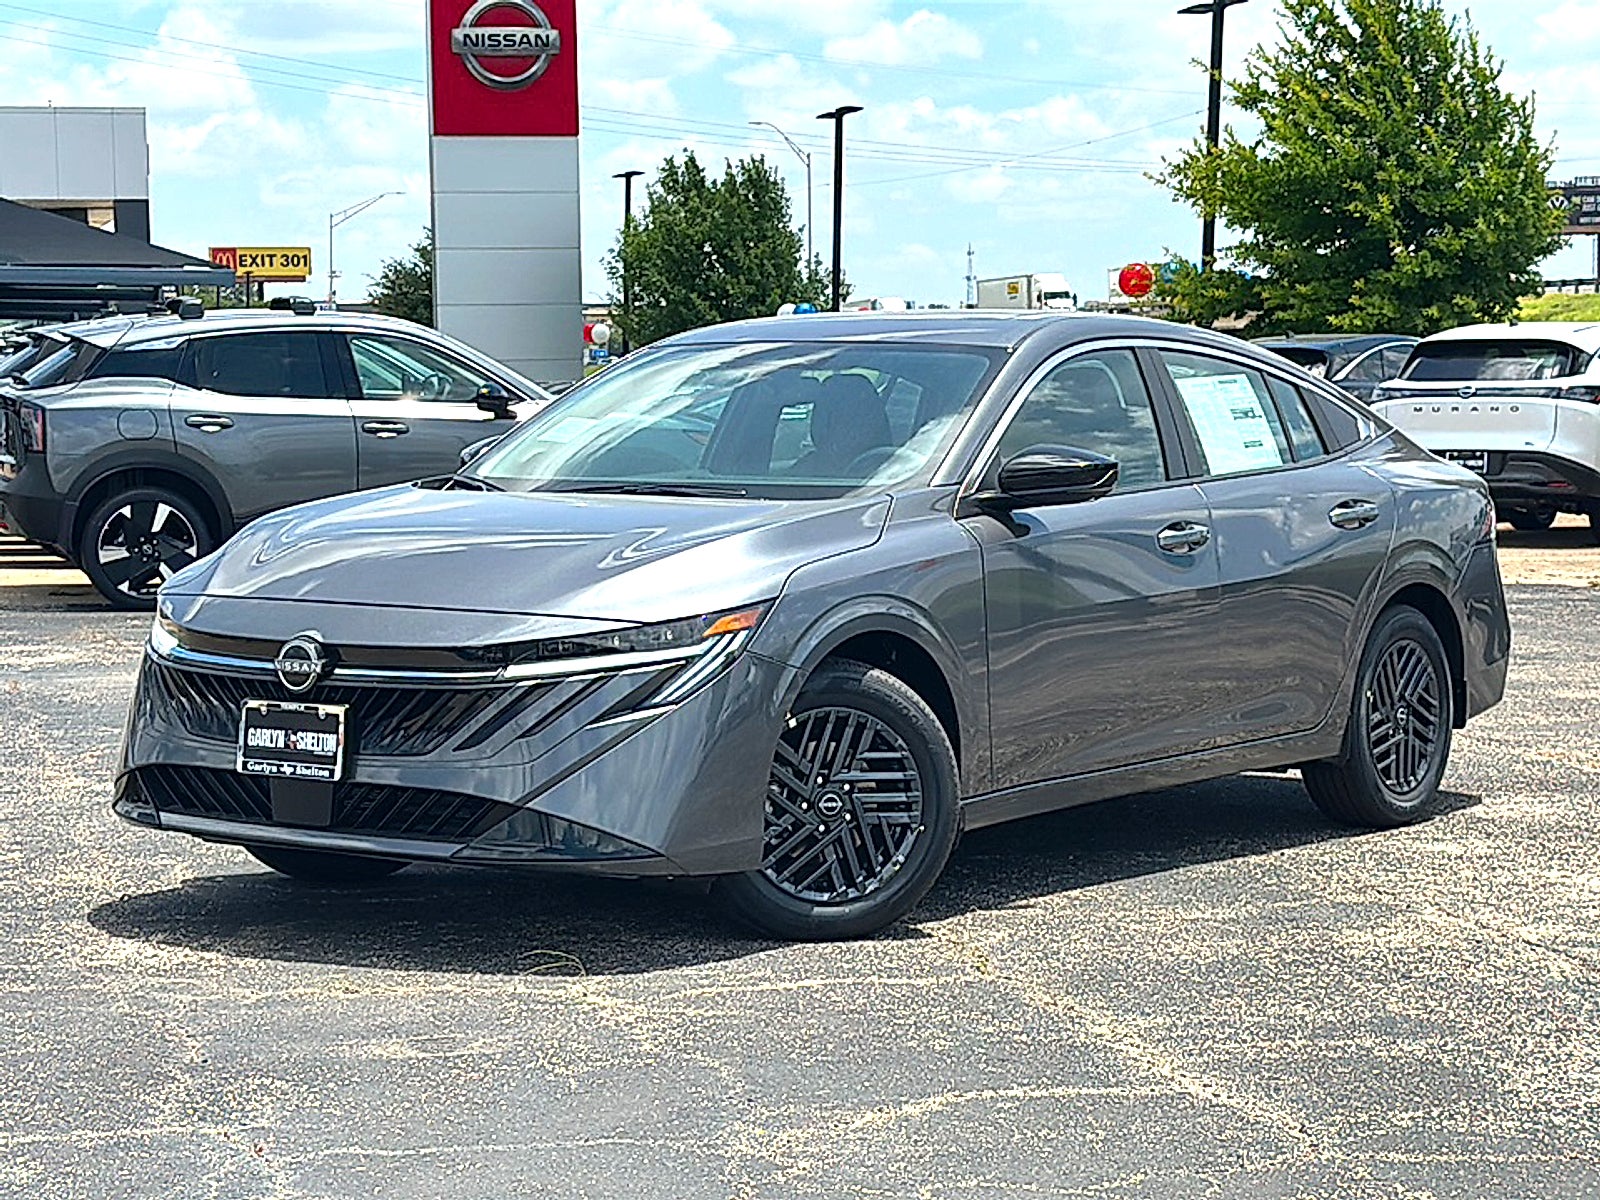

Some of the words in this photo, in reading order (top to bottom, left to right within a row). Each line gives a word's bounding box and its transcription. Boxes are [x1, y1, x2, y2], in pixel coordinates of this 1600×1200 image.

[463, 34, 551, 48] NISSAN
[239, 254, 276, 267] EXIT
[280, 254, 307, 267] 301
[1413, 405, 1520, 413] MURANO
[248, 727, 285, 748] GARLYN
[296, 731, 337, 752] SHELTON
[247, 761, 278, 774] Garlyn
[295, 765, 330, 777] Shelton
